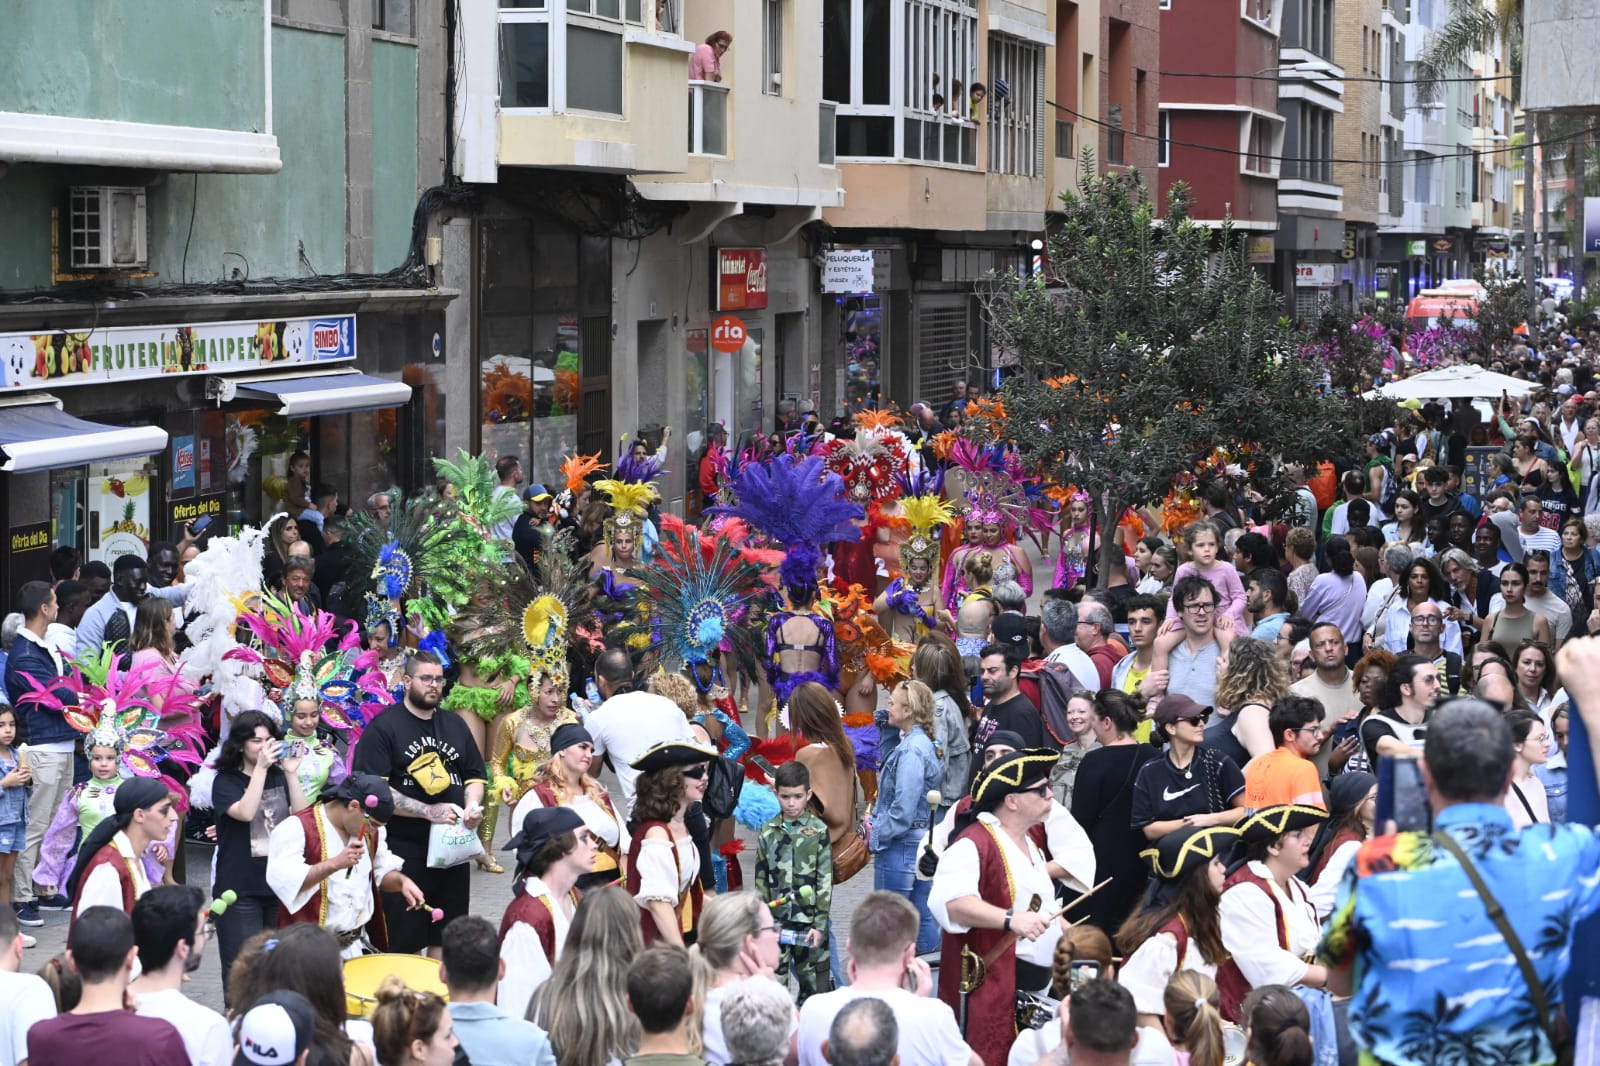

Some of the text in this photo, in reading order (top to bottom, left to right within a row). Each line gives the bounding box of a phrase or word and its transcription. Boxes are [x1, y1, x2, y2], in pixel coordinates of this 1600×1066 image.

[314, 329, 338, 349] BIMBO
[715, 320, 743, 339] ria
[91, 333, 256, 371] FRUTERÍA MAIPEZ
[174, 505, 197, 520] Oferta
[197, 501, 208, 514] del
[405, 741, 421, 759] LOS
[246, 1036, 279, 1058] FILA
